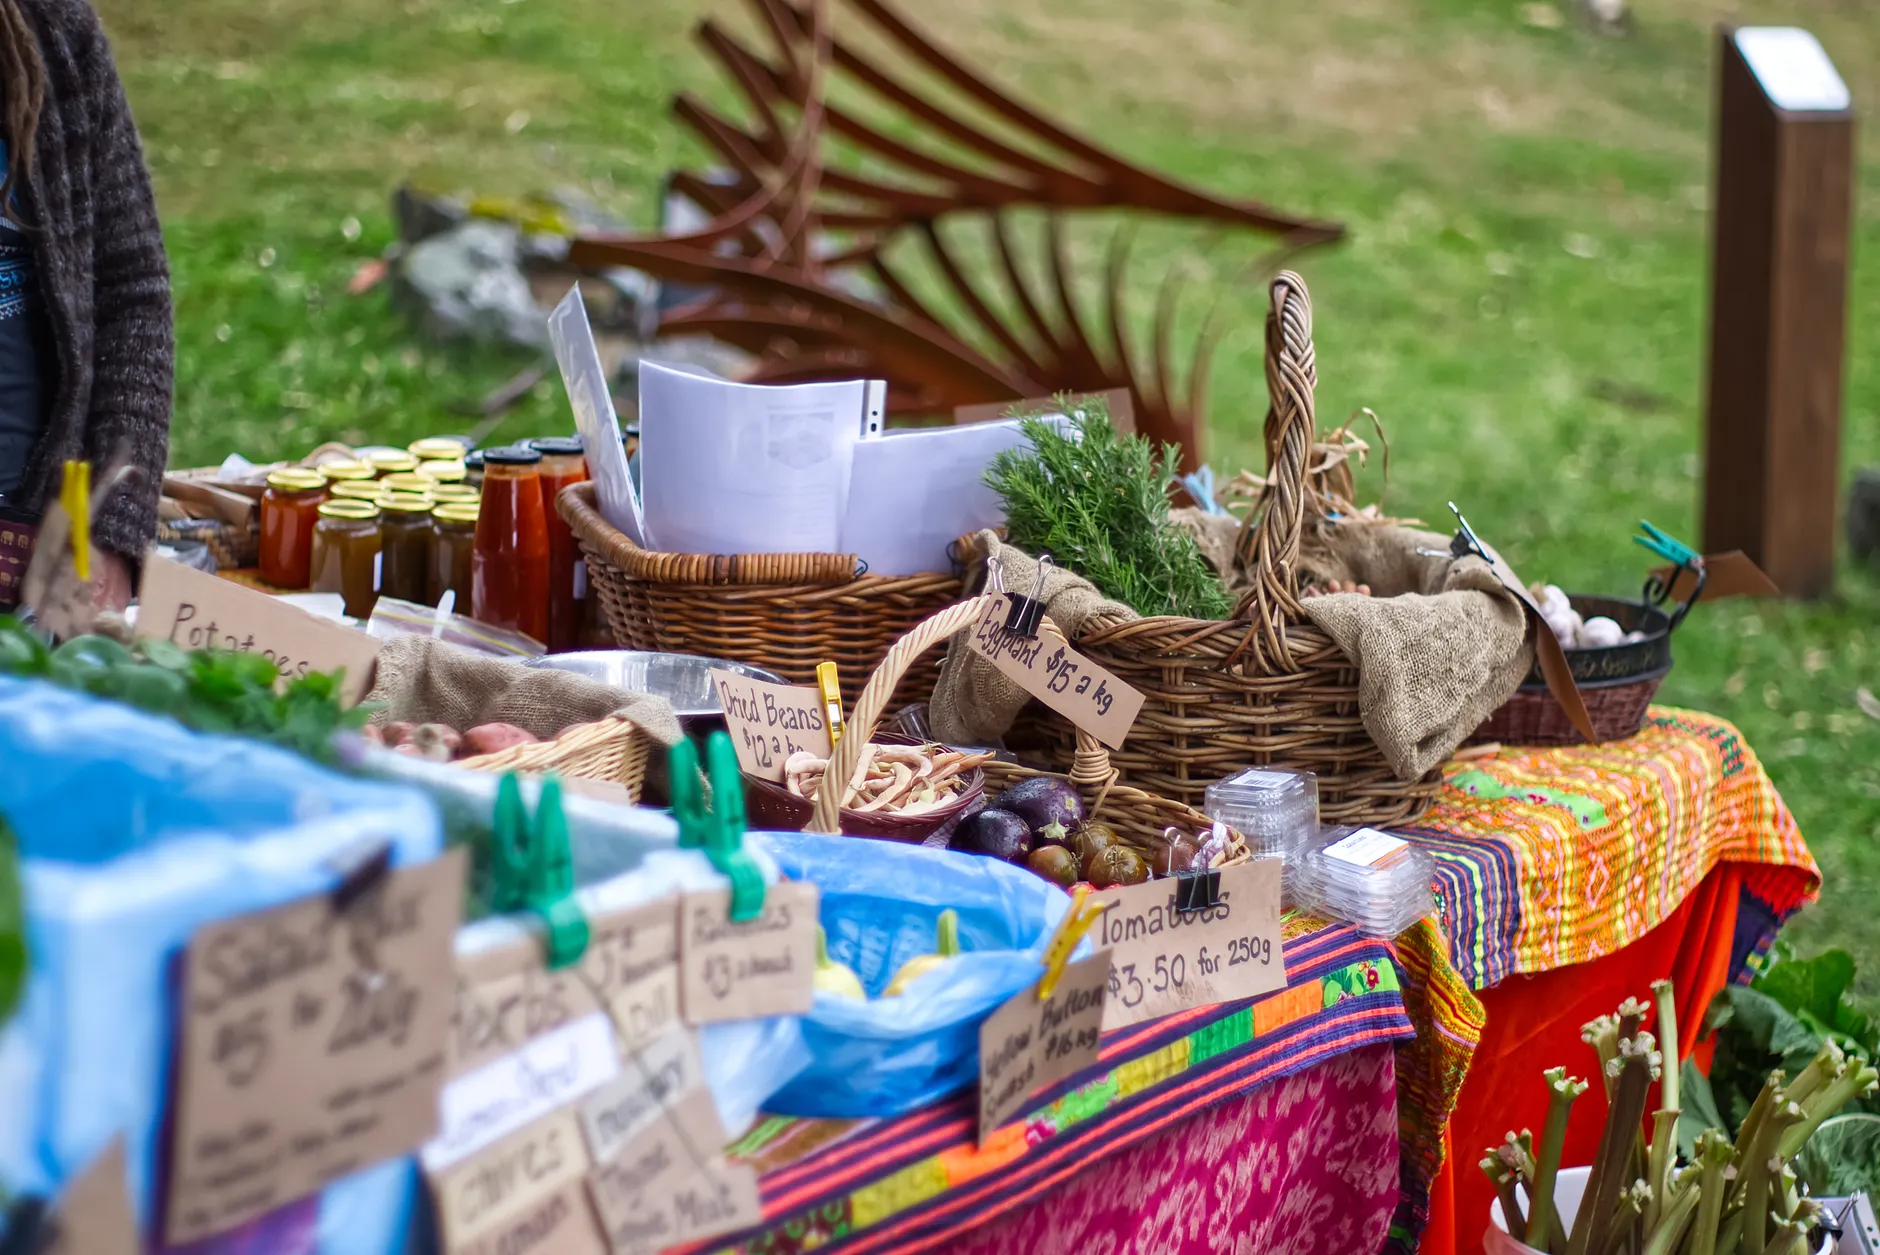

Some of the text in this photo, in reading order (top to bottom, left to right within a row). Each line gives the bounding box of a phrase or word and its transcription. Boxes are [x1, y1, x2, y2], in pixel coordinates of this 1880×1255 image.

[720, 681, 822, 730] Dried Beans
[1046, 647, 1078, 693] $15
[1075, 676, 1091, 694] a
[1092, 679, 1113, 716] kg
[743, 727, 772, 768] $12
[772, 736, 781, 754] a
[1108, 936, 1270, 1008] $3.50 for 250g
